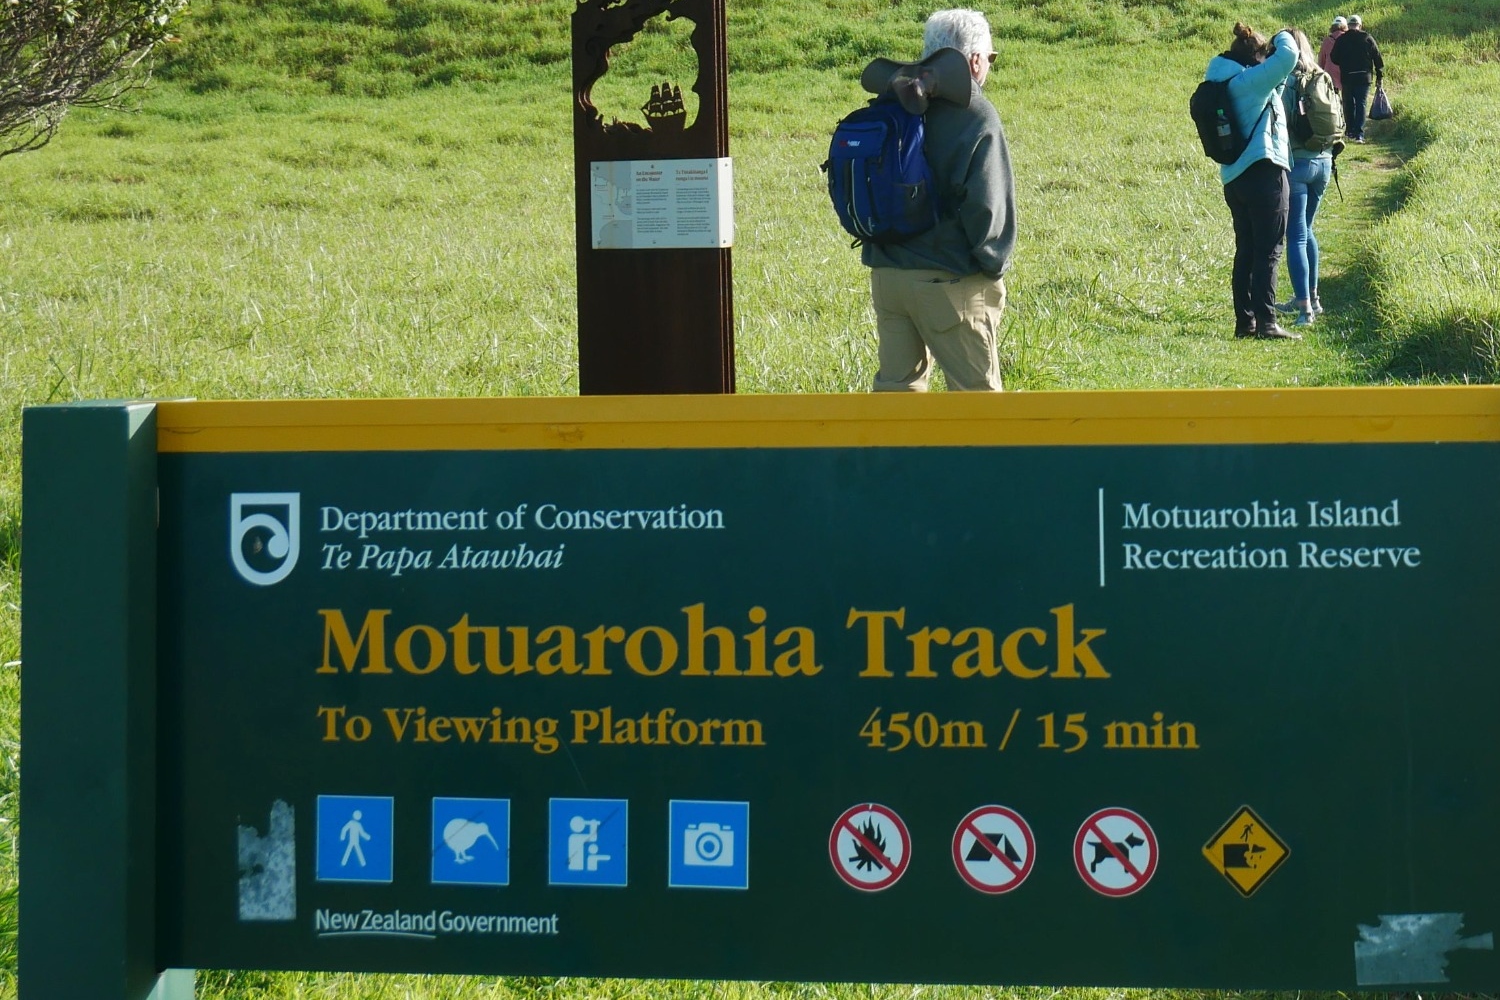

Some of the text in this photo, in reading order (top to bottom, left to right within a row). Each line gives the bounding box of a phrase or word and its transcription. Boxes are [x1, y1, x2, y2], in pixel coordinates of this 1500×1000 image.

[320, 503, 725, 538] Department of Conservation
[1121, 499, 1401, 529] Motuarohia Island
[321, 542, 565, 576] Te Papa Atawhai
[1122, 542, 1421, 569] Recreation Reserve
[315, 603, 1111, 679] Motuarohia Track
[316, 706, 766, 754] To Viewing Platform
[859, 706, 988, 752] 450m
[1036, 711, 1088, 753] 15
[1103, 711, 1200, 749] min
[438, 910, 560, 935] Government
